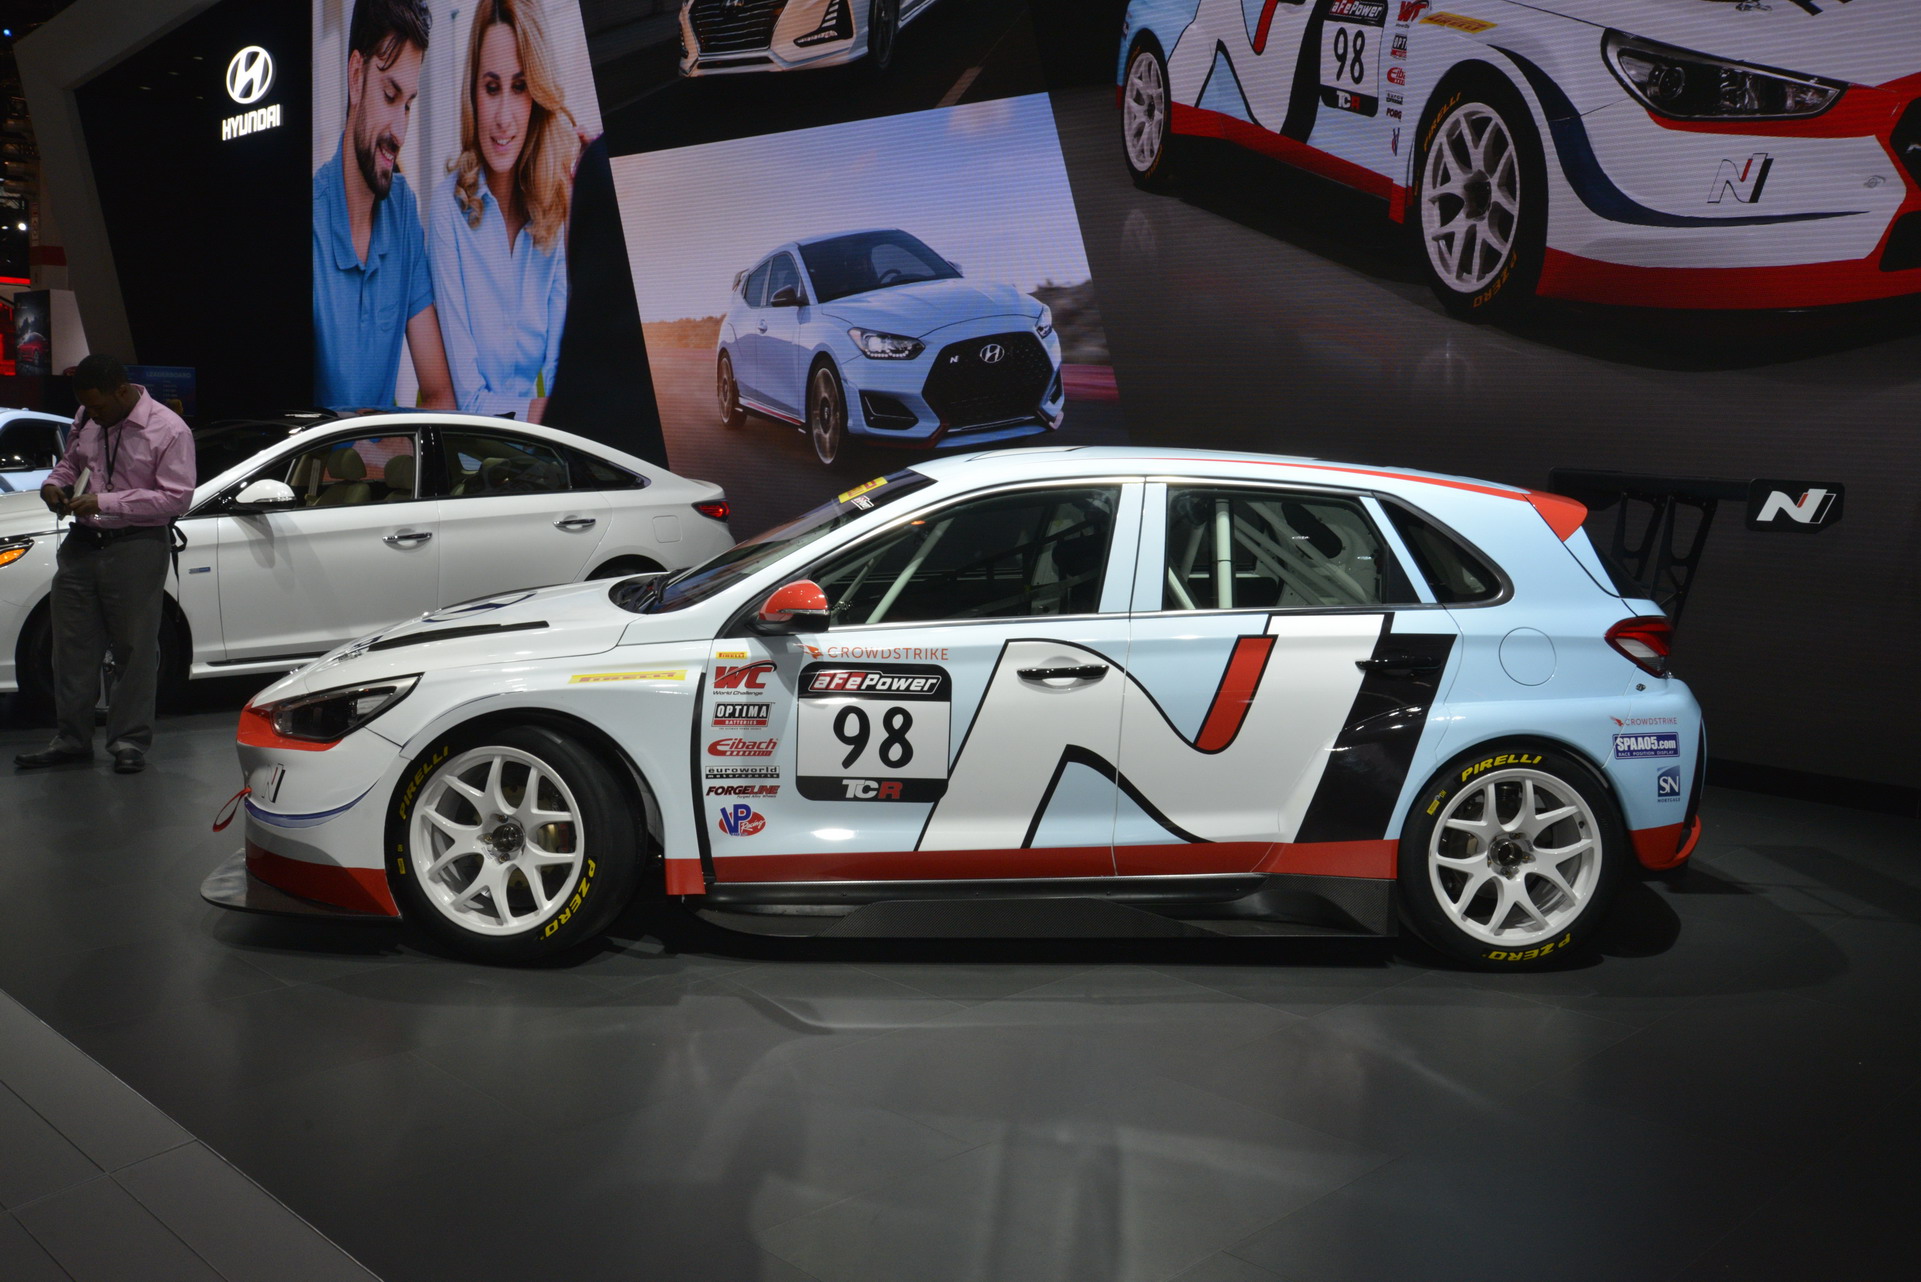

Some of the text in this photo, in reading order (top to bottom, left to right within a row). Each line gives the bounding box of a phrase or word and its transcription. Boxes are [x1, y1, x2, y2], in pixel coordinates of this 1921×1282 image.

[1334, 27, 1366, 85] 98
[222, 104, 281, 141] HYUNDAI
[827, 646, 949, 661] CROWDSTRIKE
[714, 661, 777, 689] WC
[716, 705, 768, 718] OPTIMA
[1625, 717, 1678, 726] CROWDSTRIKE
[708, 738, 777, 756] Eibach
[833, 705, 914, 769] 98
[1461, 754, 1542, 782] PIRELLI
[400, 745, 449, 820] PIRELLI
[706, 785, 780, 796] FORGELINE
[842, 779, 903, 799] TCR
[1659, 776, 1679, 794] SN
[720, 804, 752, 836] VP
[740, 819, 766, 833] Racing
[545, 858, 596, 937] P ZERO
[1488, 932, 1571, 961] P ZERO
